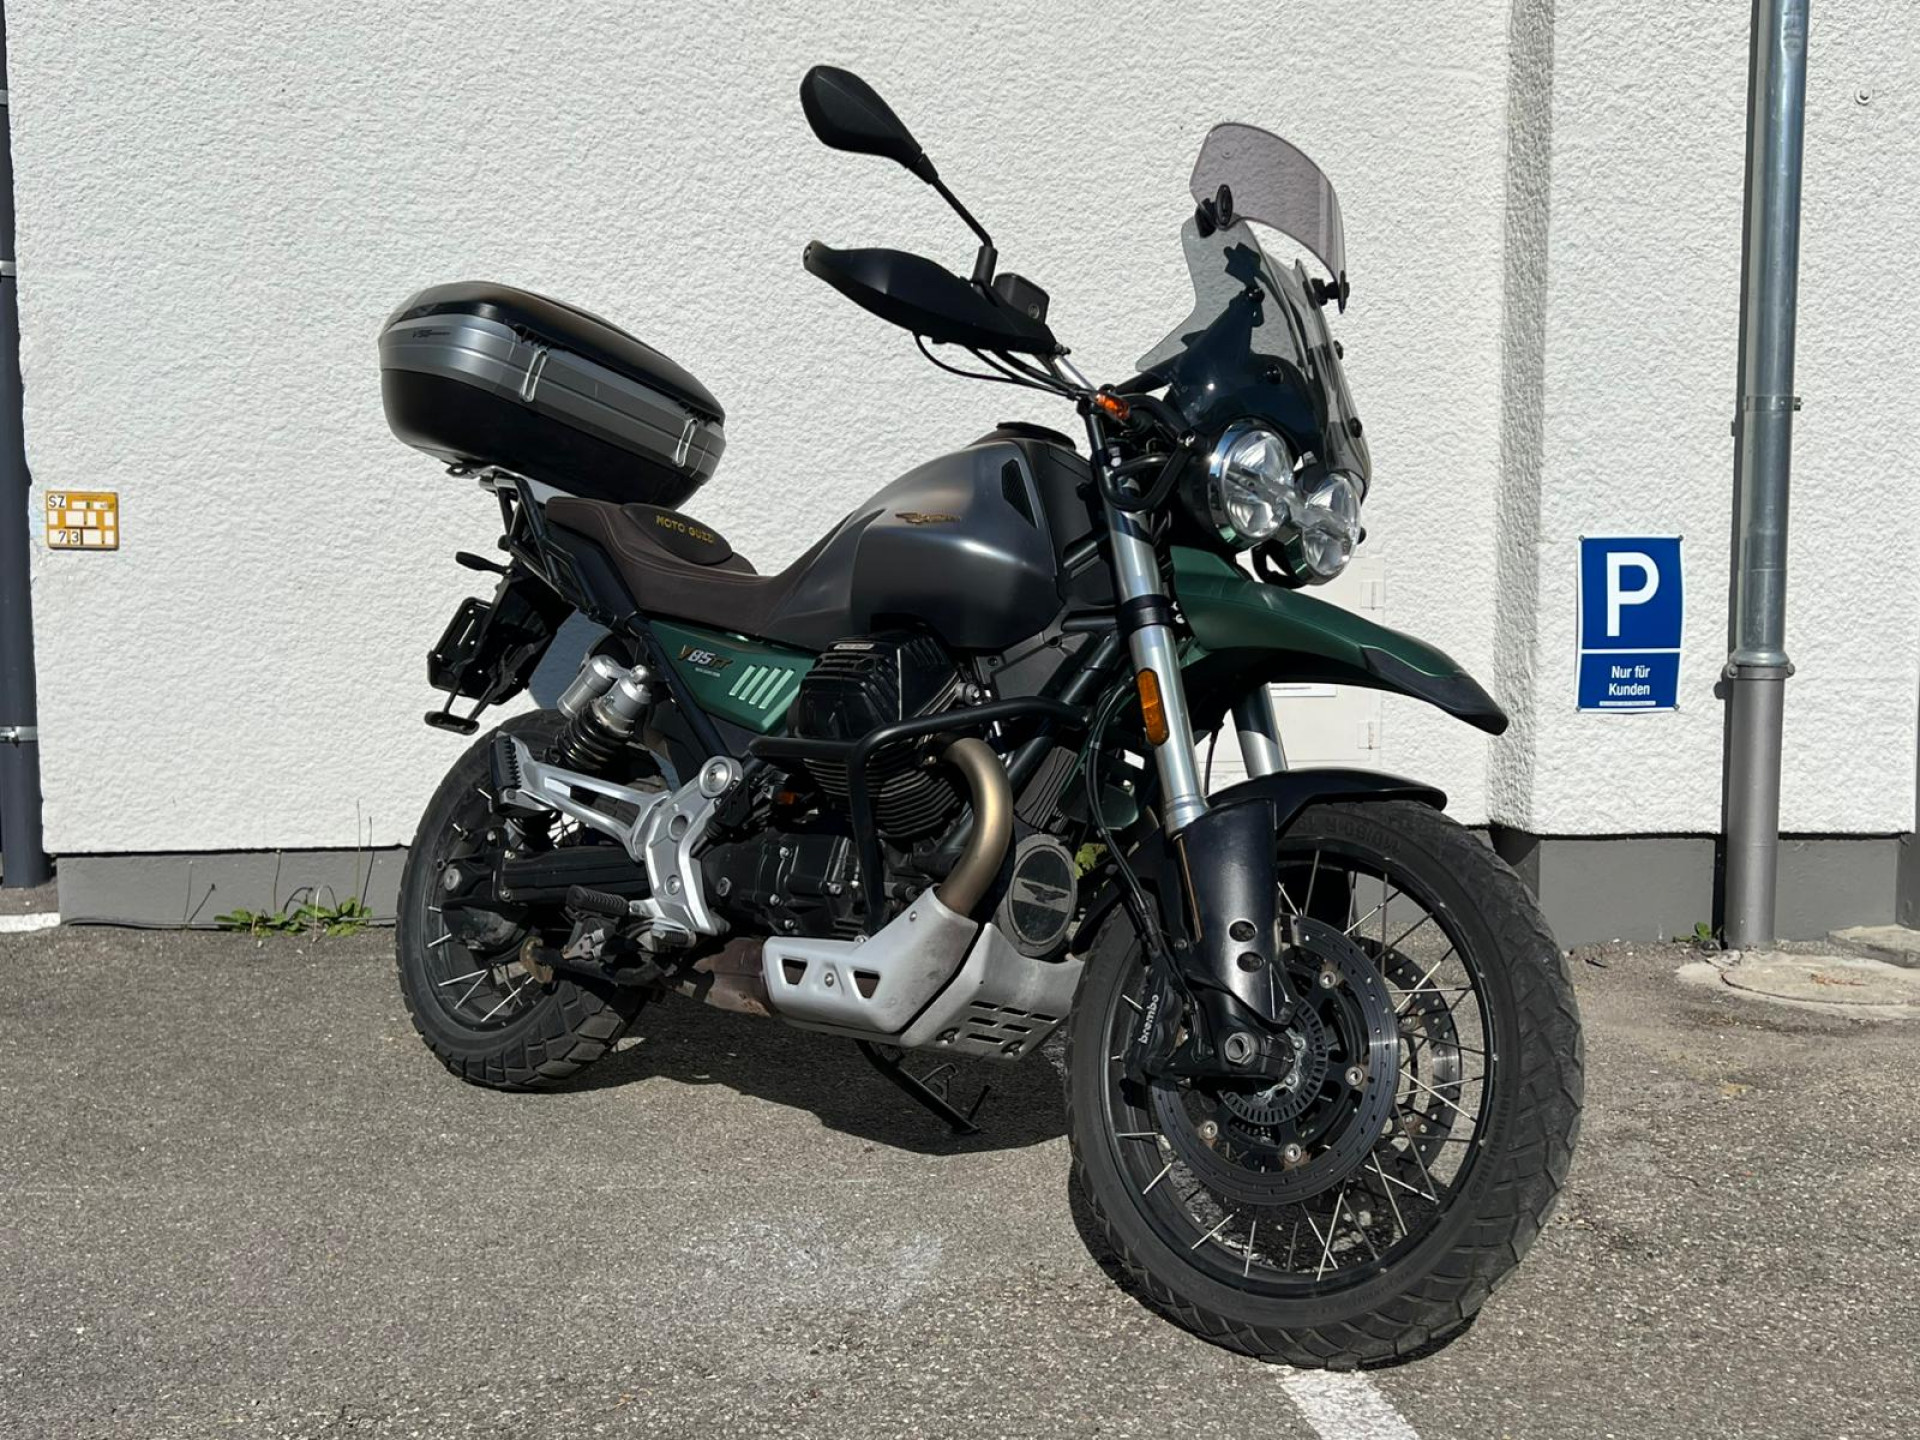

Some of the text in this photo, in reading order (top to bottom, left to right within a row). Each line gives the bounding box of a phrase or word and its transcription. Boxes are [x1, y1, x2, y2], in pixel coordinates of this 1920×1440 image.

[48, 495, 66, 508] SZ
[656, 515, 685, 533] MOTO
[1606, 552, 1660, 637] P
[1611, 665, 1651, 679] Nur für
[1608, 683, 1651, 696] Kunden
[1138, 994, 1159, 1044] brembo
